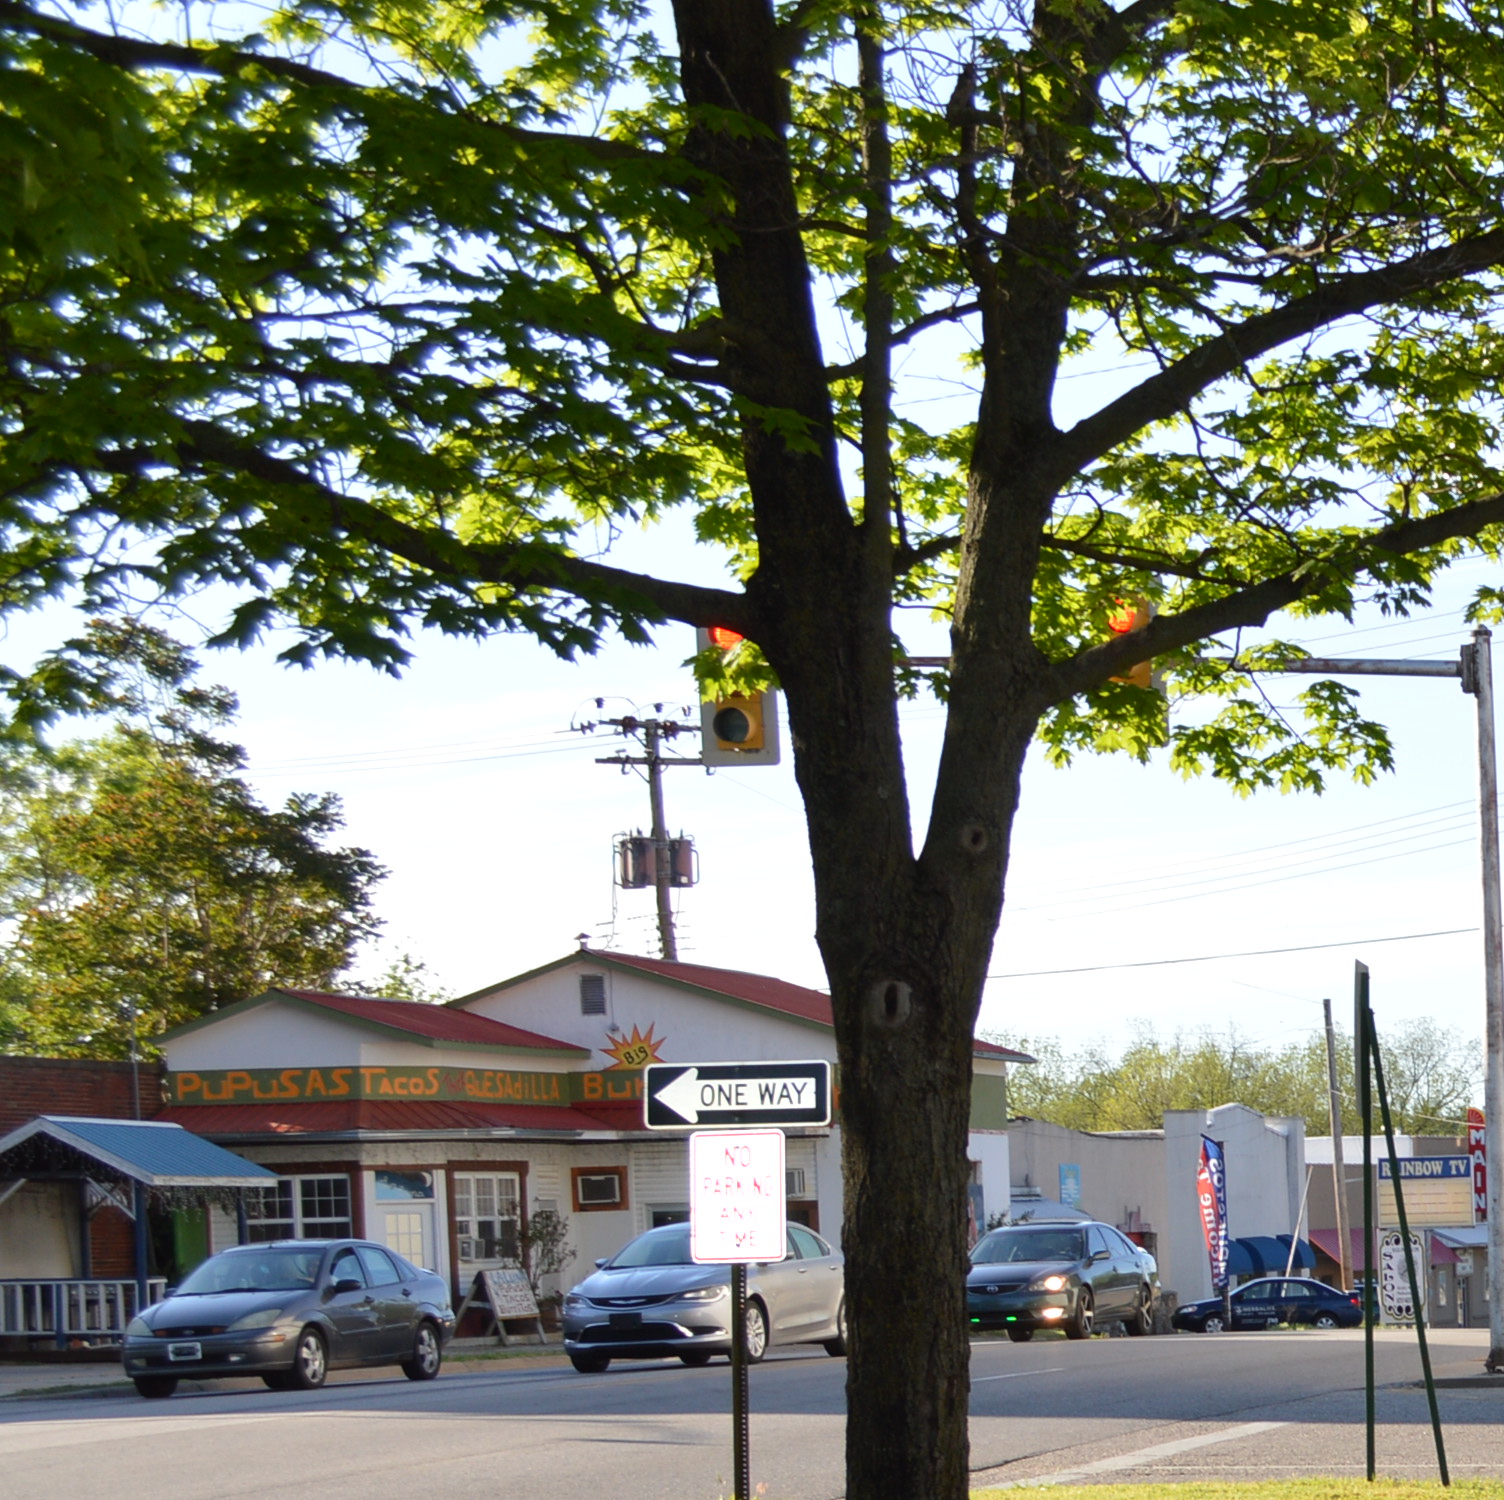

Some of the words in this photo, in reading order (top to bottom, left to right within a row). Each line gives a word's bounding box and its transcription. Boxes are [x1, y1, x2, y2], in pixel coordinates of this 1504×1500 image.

[624, 1046, 649, 1066] Big
[700, 1083, 748, 1107] ONE
[758, 1082, 808, 1105] WAY
[725, 1146, 751, 1168] NO
[1449, 1159, 1468, 1175] TV
[1469, 1129, 1486, 1209] MAIN
[704, 1176, 774, 1197] PARKNG
[720, 1230, 760, 1247] TME
[1382, 1252, 1395, 1302] SALON
